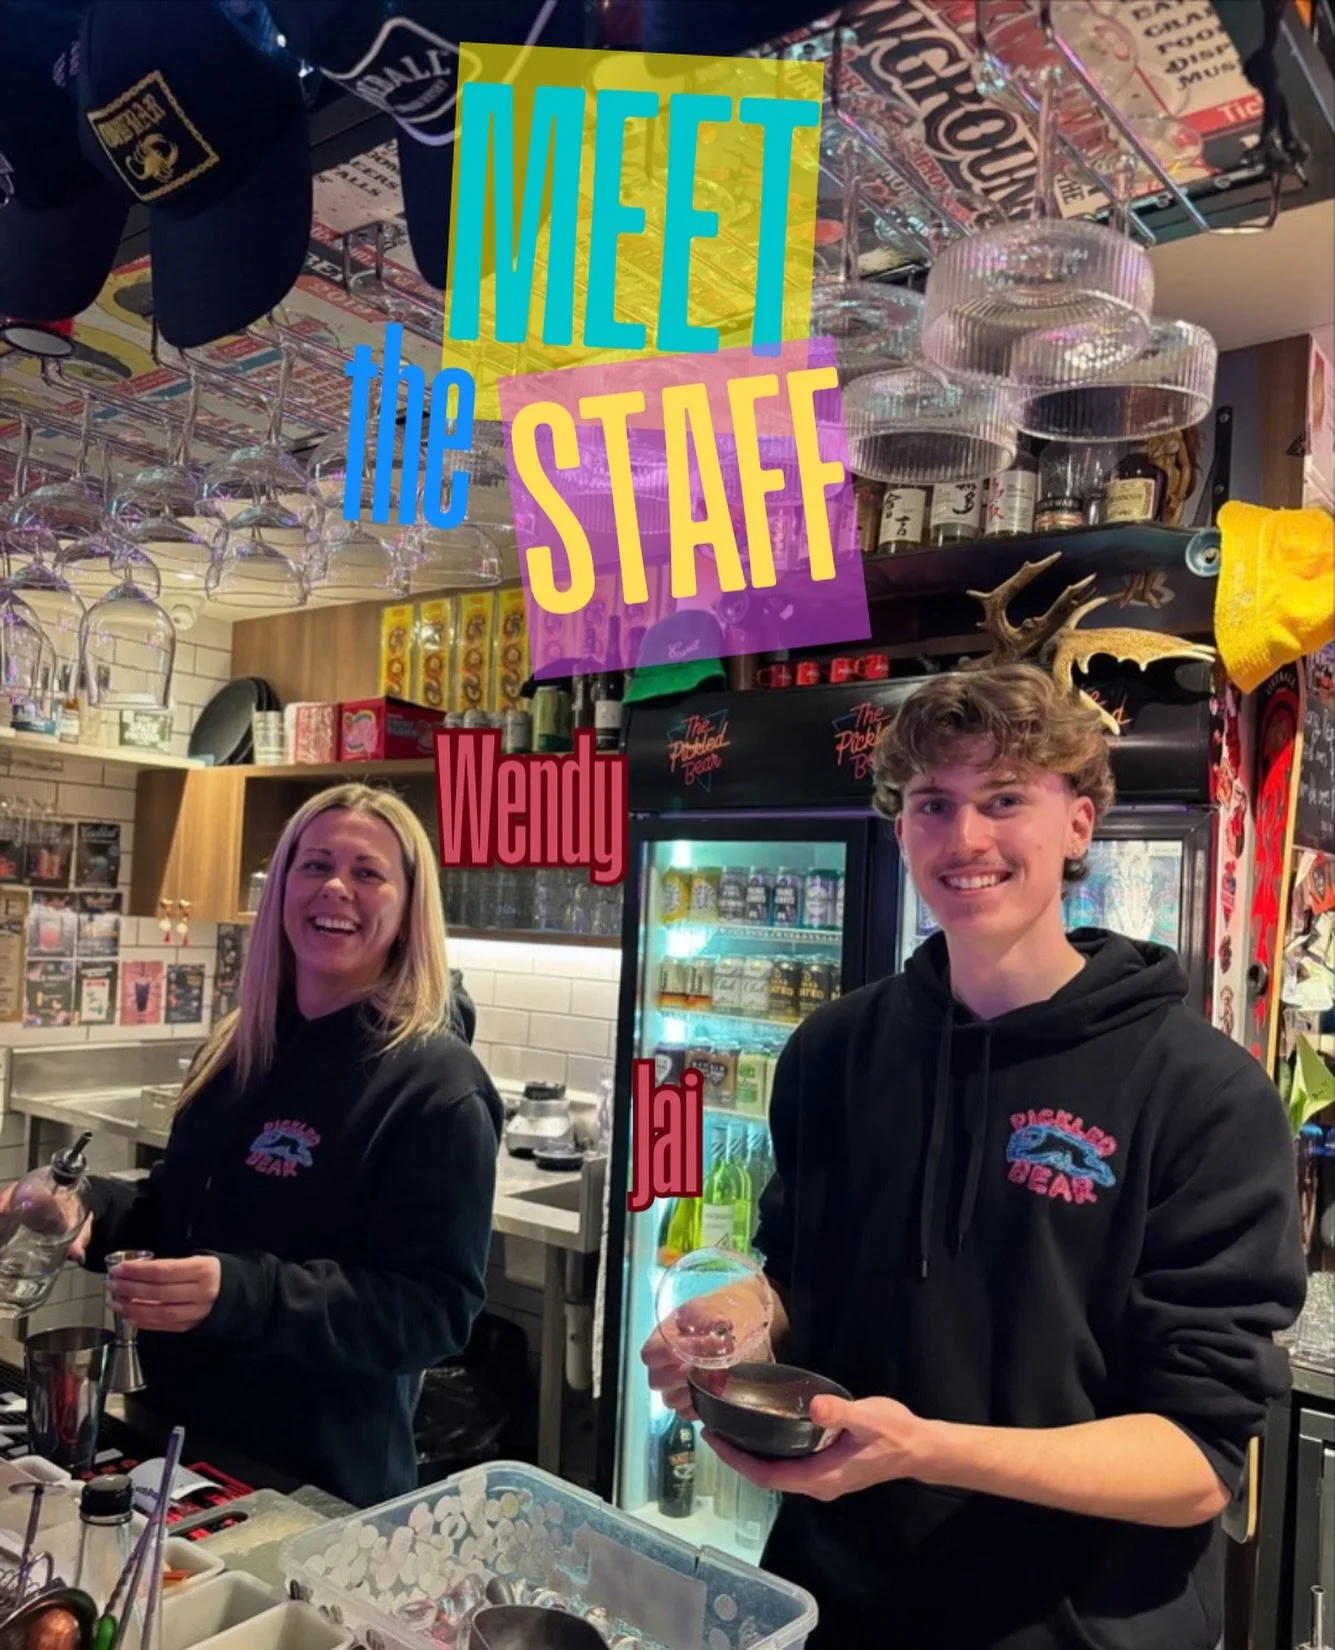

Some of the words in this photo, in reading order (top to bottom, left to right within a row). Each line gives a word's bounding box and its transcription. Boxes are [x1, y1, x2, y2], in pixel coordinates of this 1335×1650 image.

[681, 714, 716, 738] The
[849, 702, 892, 729] The
[668, 721, 731, 773] Pickled
[1010, 1107, 1118, 1157] PICKLED
[1007, 1159, 1098, 1204] BEAR
